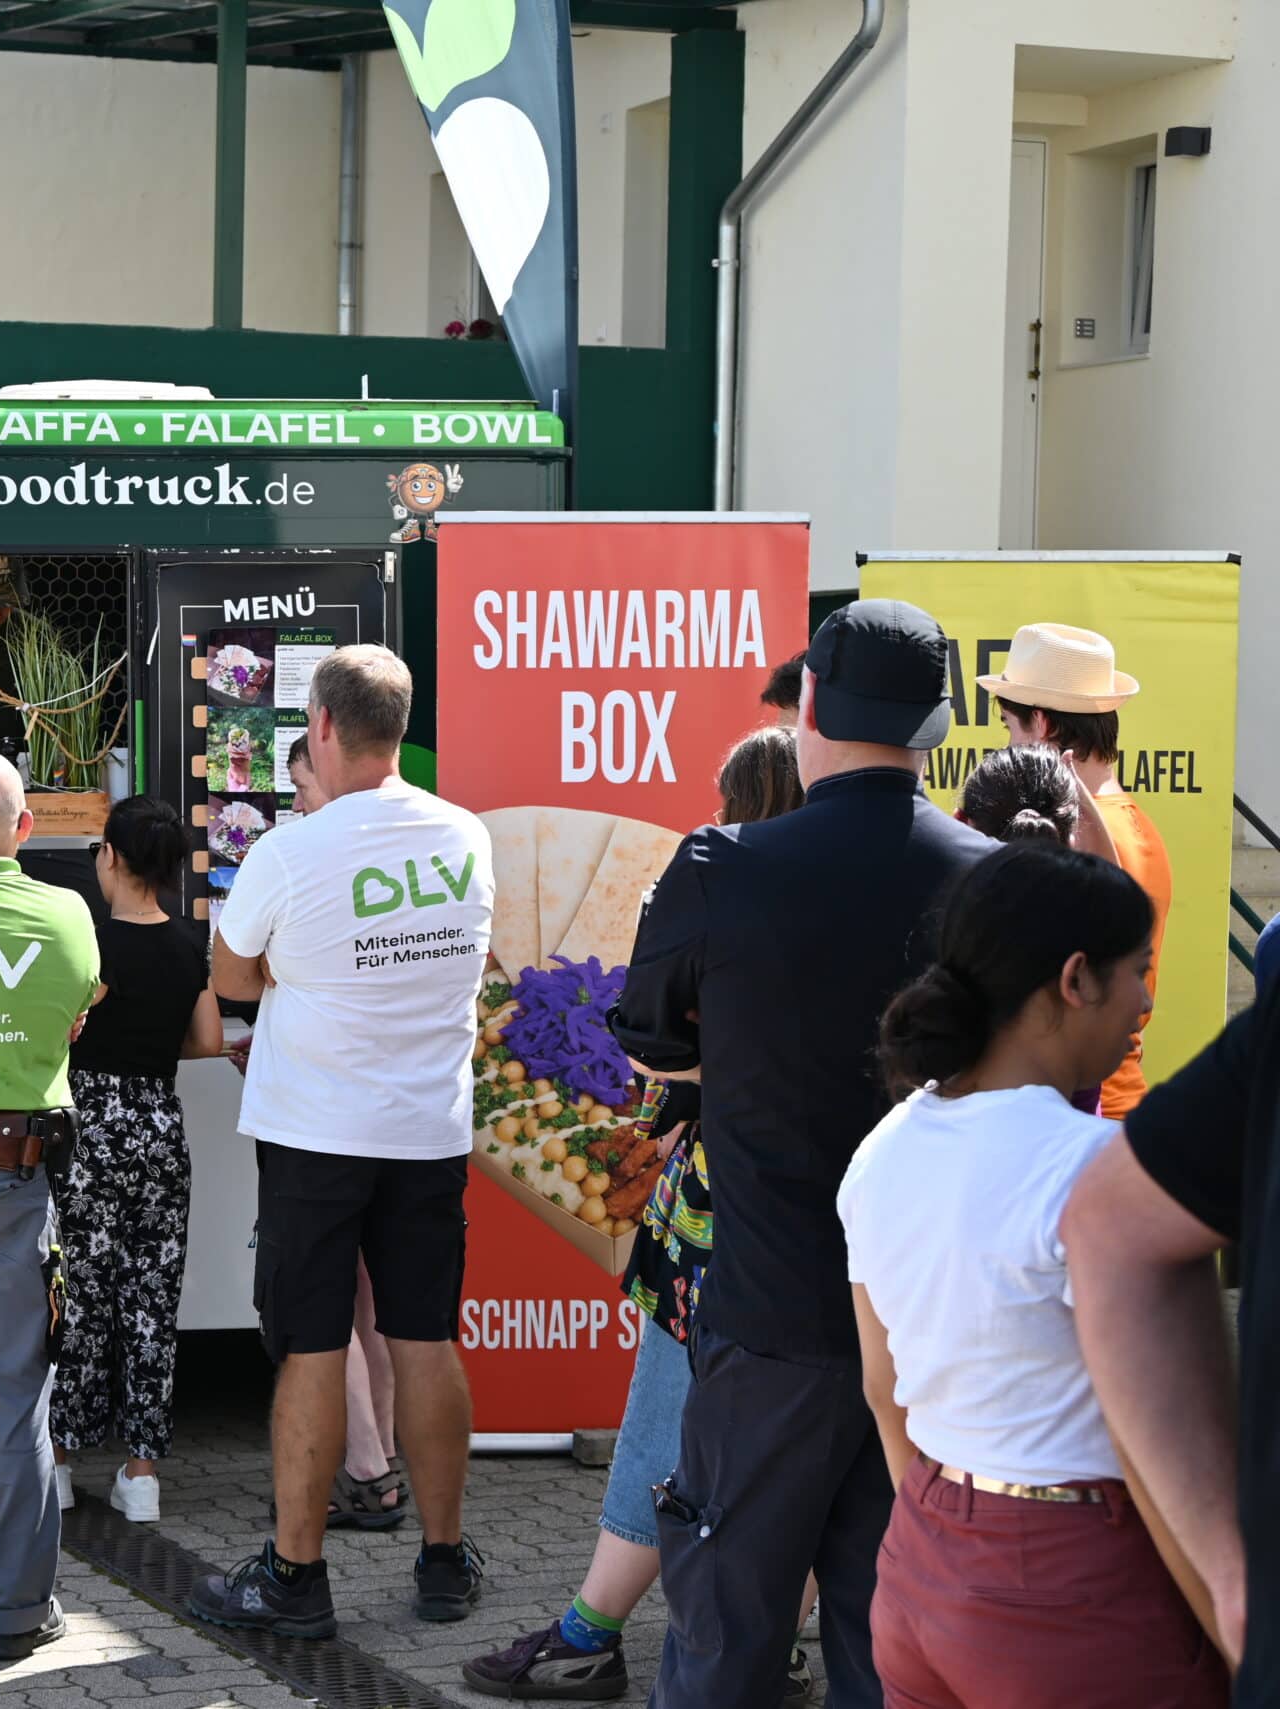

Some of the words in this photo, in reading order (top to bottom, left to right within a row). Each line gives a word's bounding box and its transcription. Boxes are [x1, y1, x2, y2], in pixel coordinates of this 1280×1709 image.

[161, 411, 361, 444] FALAFEL
[411, 412, 553, 444] BOWL
[223, 586, 316, 623] MENÜ
[279, 632, 312, 643] FALAFEL
[314, 632, 333, 643] BOX
[472, 588, 768, 670] SHAWARMA
[560, 688, 678, 783] BOX
[354, 927, 465, 953] Miteinander.
[355, 955, 389, 970] Für
[393, 943, 478, 965] Menschen.
[461, 1298, 609, 1351] SCHNAPP
[274, 1558, 296, 1577] CAT
